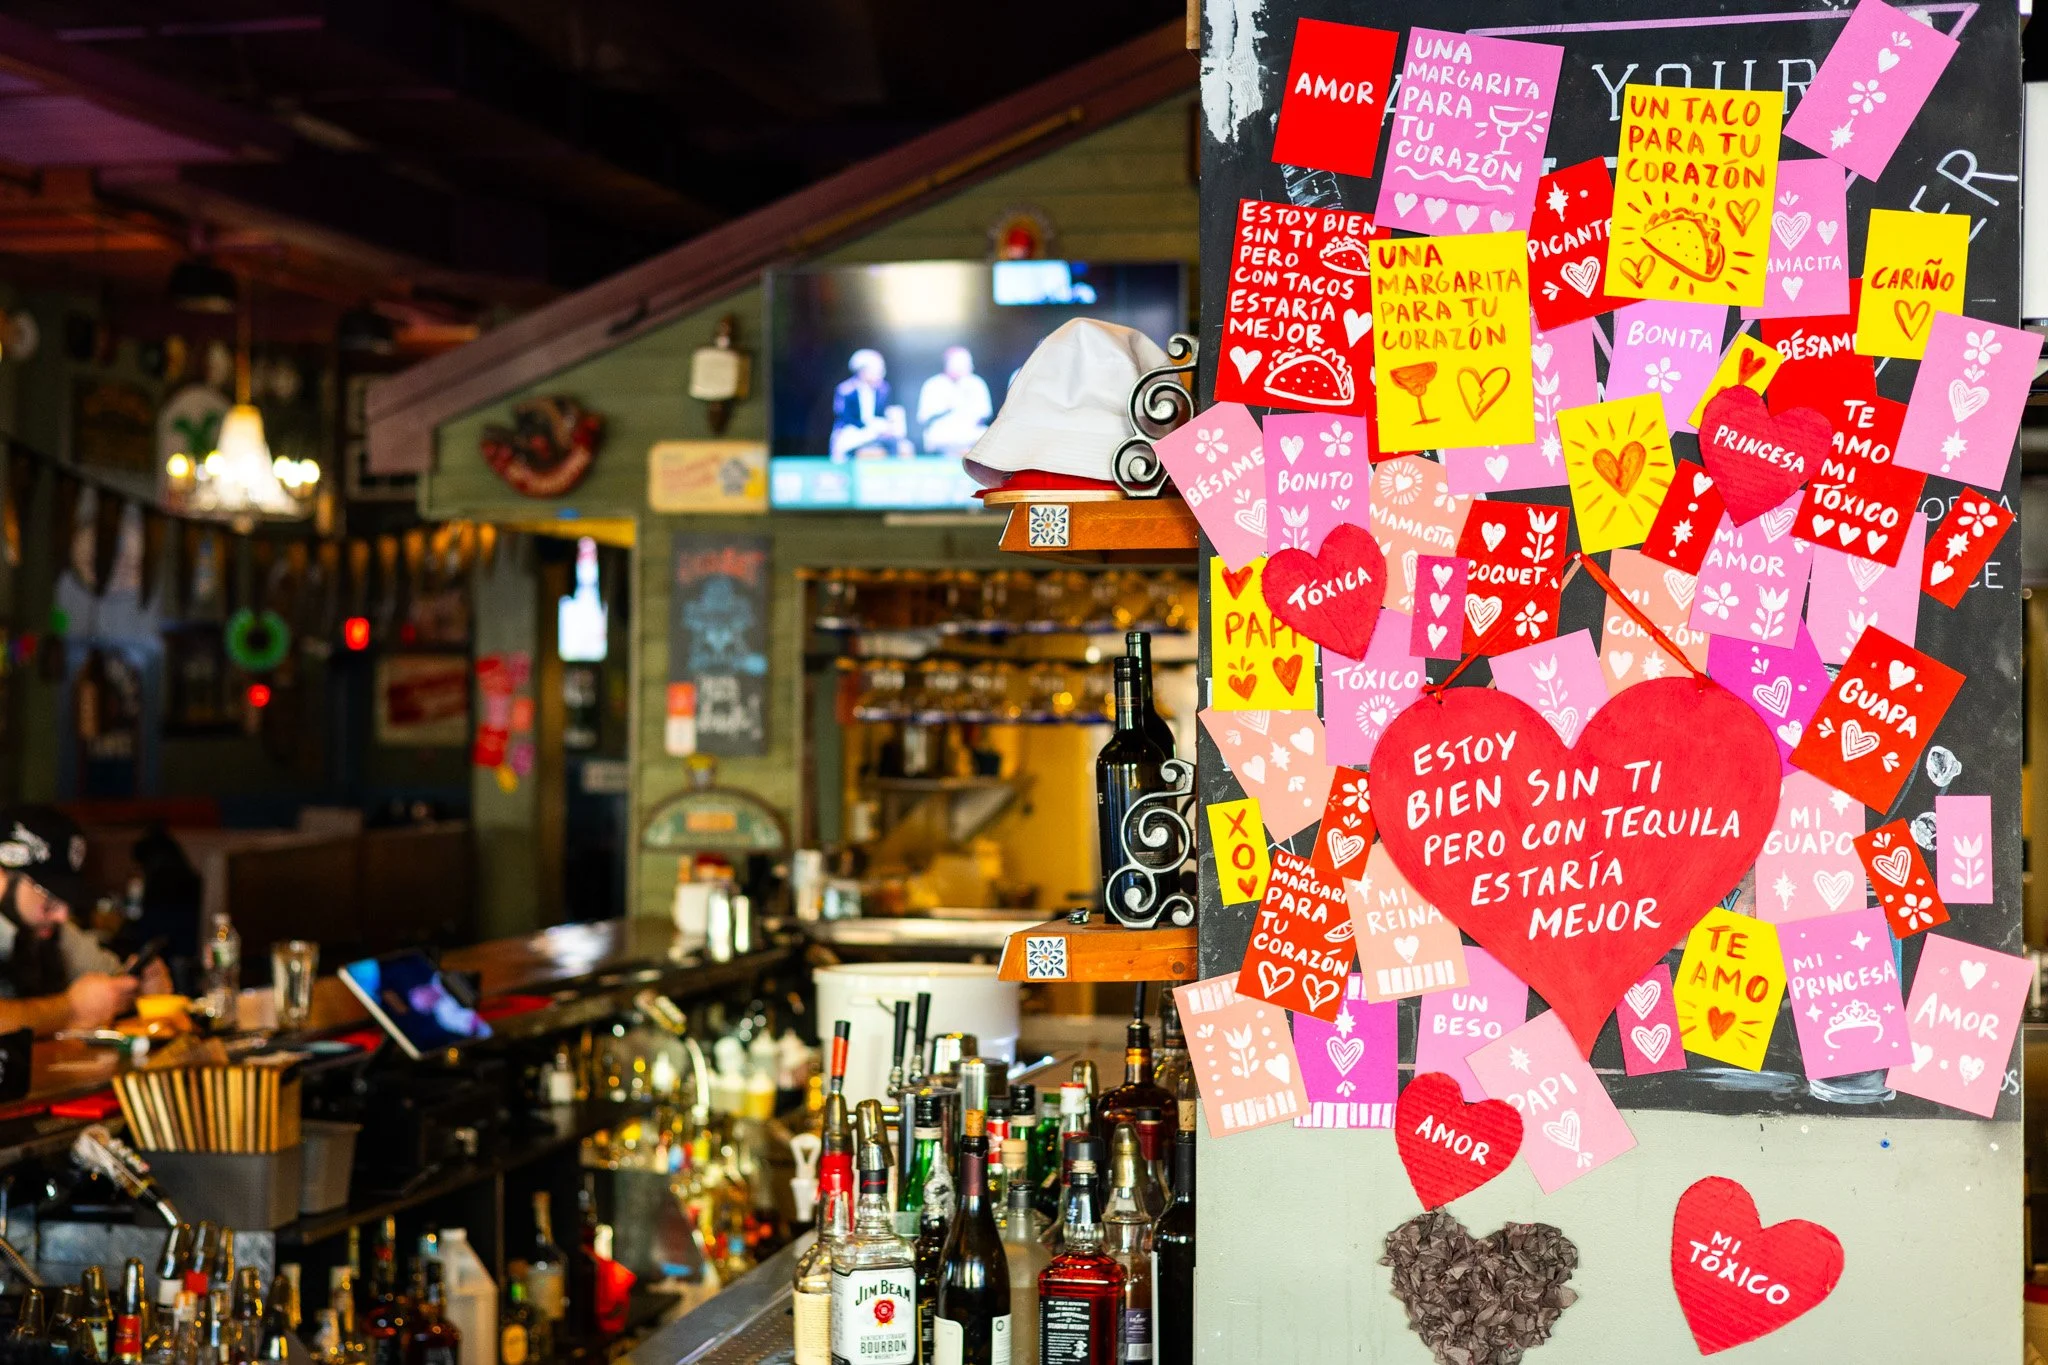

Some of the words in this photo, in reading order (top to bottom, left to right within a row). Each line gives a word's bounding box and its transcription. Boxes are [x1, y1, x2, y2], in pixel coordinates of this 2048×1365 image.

[1415, 36, 1472, 64] UNA
[1295, 72, 1374, 105] AMOR
[1407, 62, 1540, 99] MARGARITA
[1403, 87, 1472, 119] PARA
[1631, 95, 1669, 120] UN
[1681, 97, 1761, 127] TACO
[1399, 115, 1434, 141] TU
[1629, 125, 1705, 157] PARA
[1718, 132, 1761, 158] TU
[1395, 140, 1522, 182] CORAZÓN
[1625, 158, 1765, 190] CORAZÓN
[1242, 202, 1317, 228] ESTOY
[1323, 214, 1377, 235] BIEN
[1242, 226, 1279, 244] SIN
[1289, 230, 1313, 248] TI
[1240, 245, 1299, 267] PERO
[1378, 244, 1443, 269] UNA
[1235, 267, 1278, 287] CON
[1283, 272, 1354, 300] TACOS
[1377, 268, 1522, 296] MARGARITA
[1871, 258, 1955, 291] CARIÑO
[1230, 289, 1336, 322] ESTARÍA
[1381, 300, 1452, 324] PARA
[1460, 296, 1498, 318] TU
[1229, 317, 1325, 348] MEJOR
[1381, 319, 1507, 351] CORAZÓN
[1627, 320, 1713, 353] BONITA
[1843, 400, 1875, 429] TE
[1713, 424, 1805, 474] PRINCESA
[1832, 431, 1891, 464] AMO
[1186, 446, 1265, 507] BÉSAME
[1278, 470, 1353, 495] BONITO
[1820, 458, 1856, 483] MI
[1813, 483, 1899, 528] TÓXICO
[1369, 503, 1456, 550] MAMACITA
[1714, 528, 1743, 548] MI
[1706, 549, 1785, 577] AMOR
[1287, 566, 1372, 611] TÓXICA
[1331, 662, 1419, 691] TÓXICO
[1839, 677, 1917, 739] GUAPA
[1413, 729, 1517, 776] ESTOY
[1406, 775, 1501, 830] BIEN
[1527, 766, 1599, 807] SIN
[1624, 760, 1662, 794] TI
[1790, 806, 1820, 829] MI
[1424, 829, 1506, 867] PERO
[1521, 817, 1586, 852] CON
[1601, 805, 1740, 840] TEQUILA
[1763, 830, 1854, 855] GUAPO
[1277, 854, 1316, 879] UNA
[1470, 850, 1623, 906] ESTARÍA
[1266, 887, 1328, 924] PARA
[1379, 887, 1408, 907] MI
[1261, 911, 1289, 935] TU
[1366, 904, 1444, 937] REINA
[1528, 897, 1662, 941] MEJOR
[1253, 933, 1349, 977] CORAZÓN
[1706, 925, 1749, 960] TE
[1793, 954, 1823, 973] MI
[1690, 960, 1769, 1003] AMO
[1792, 959, 1897, 1001] PRINCESA
[1452, 993, 1488, 1012] UN
[1914, 992, 1999, 1041] AMOR
[1433, 1014, 1502, 1039] BESO
[1415, 1114, 1490, 1166] AMOR
[1711, 1231, 1742, 1255] MI
[855, 1284, 877, 1306] JIM
[880, 1279, 911, 1303] BEAM
[860, 1340, 907, 1354] BOURBON
